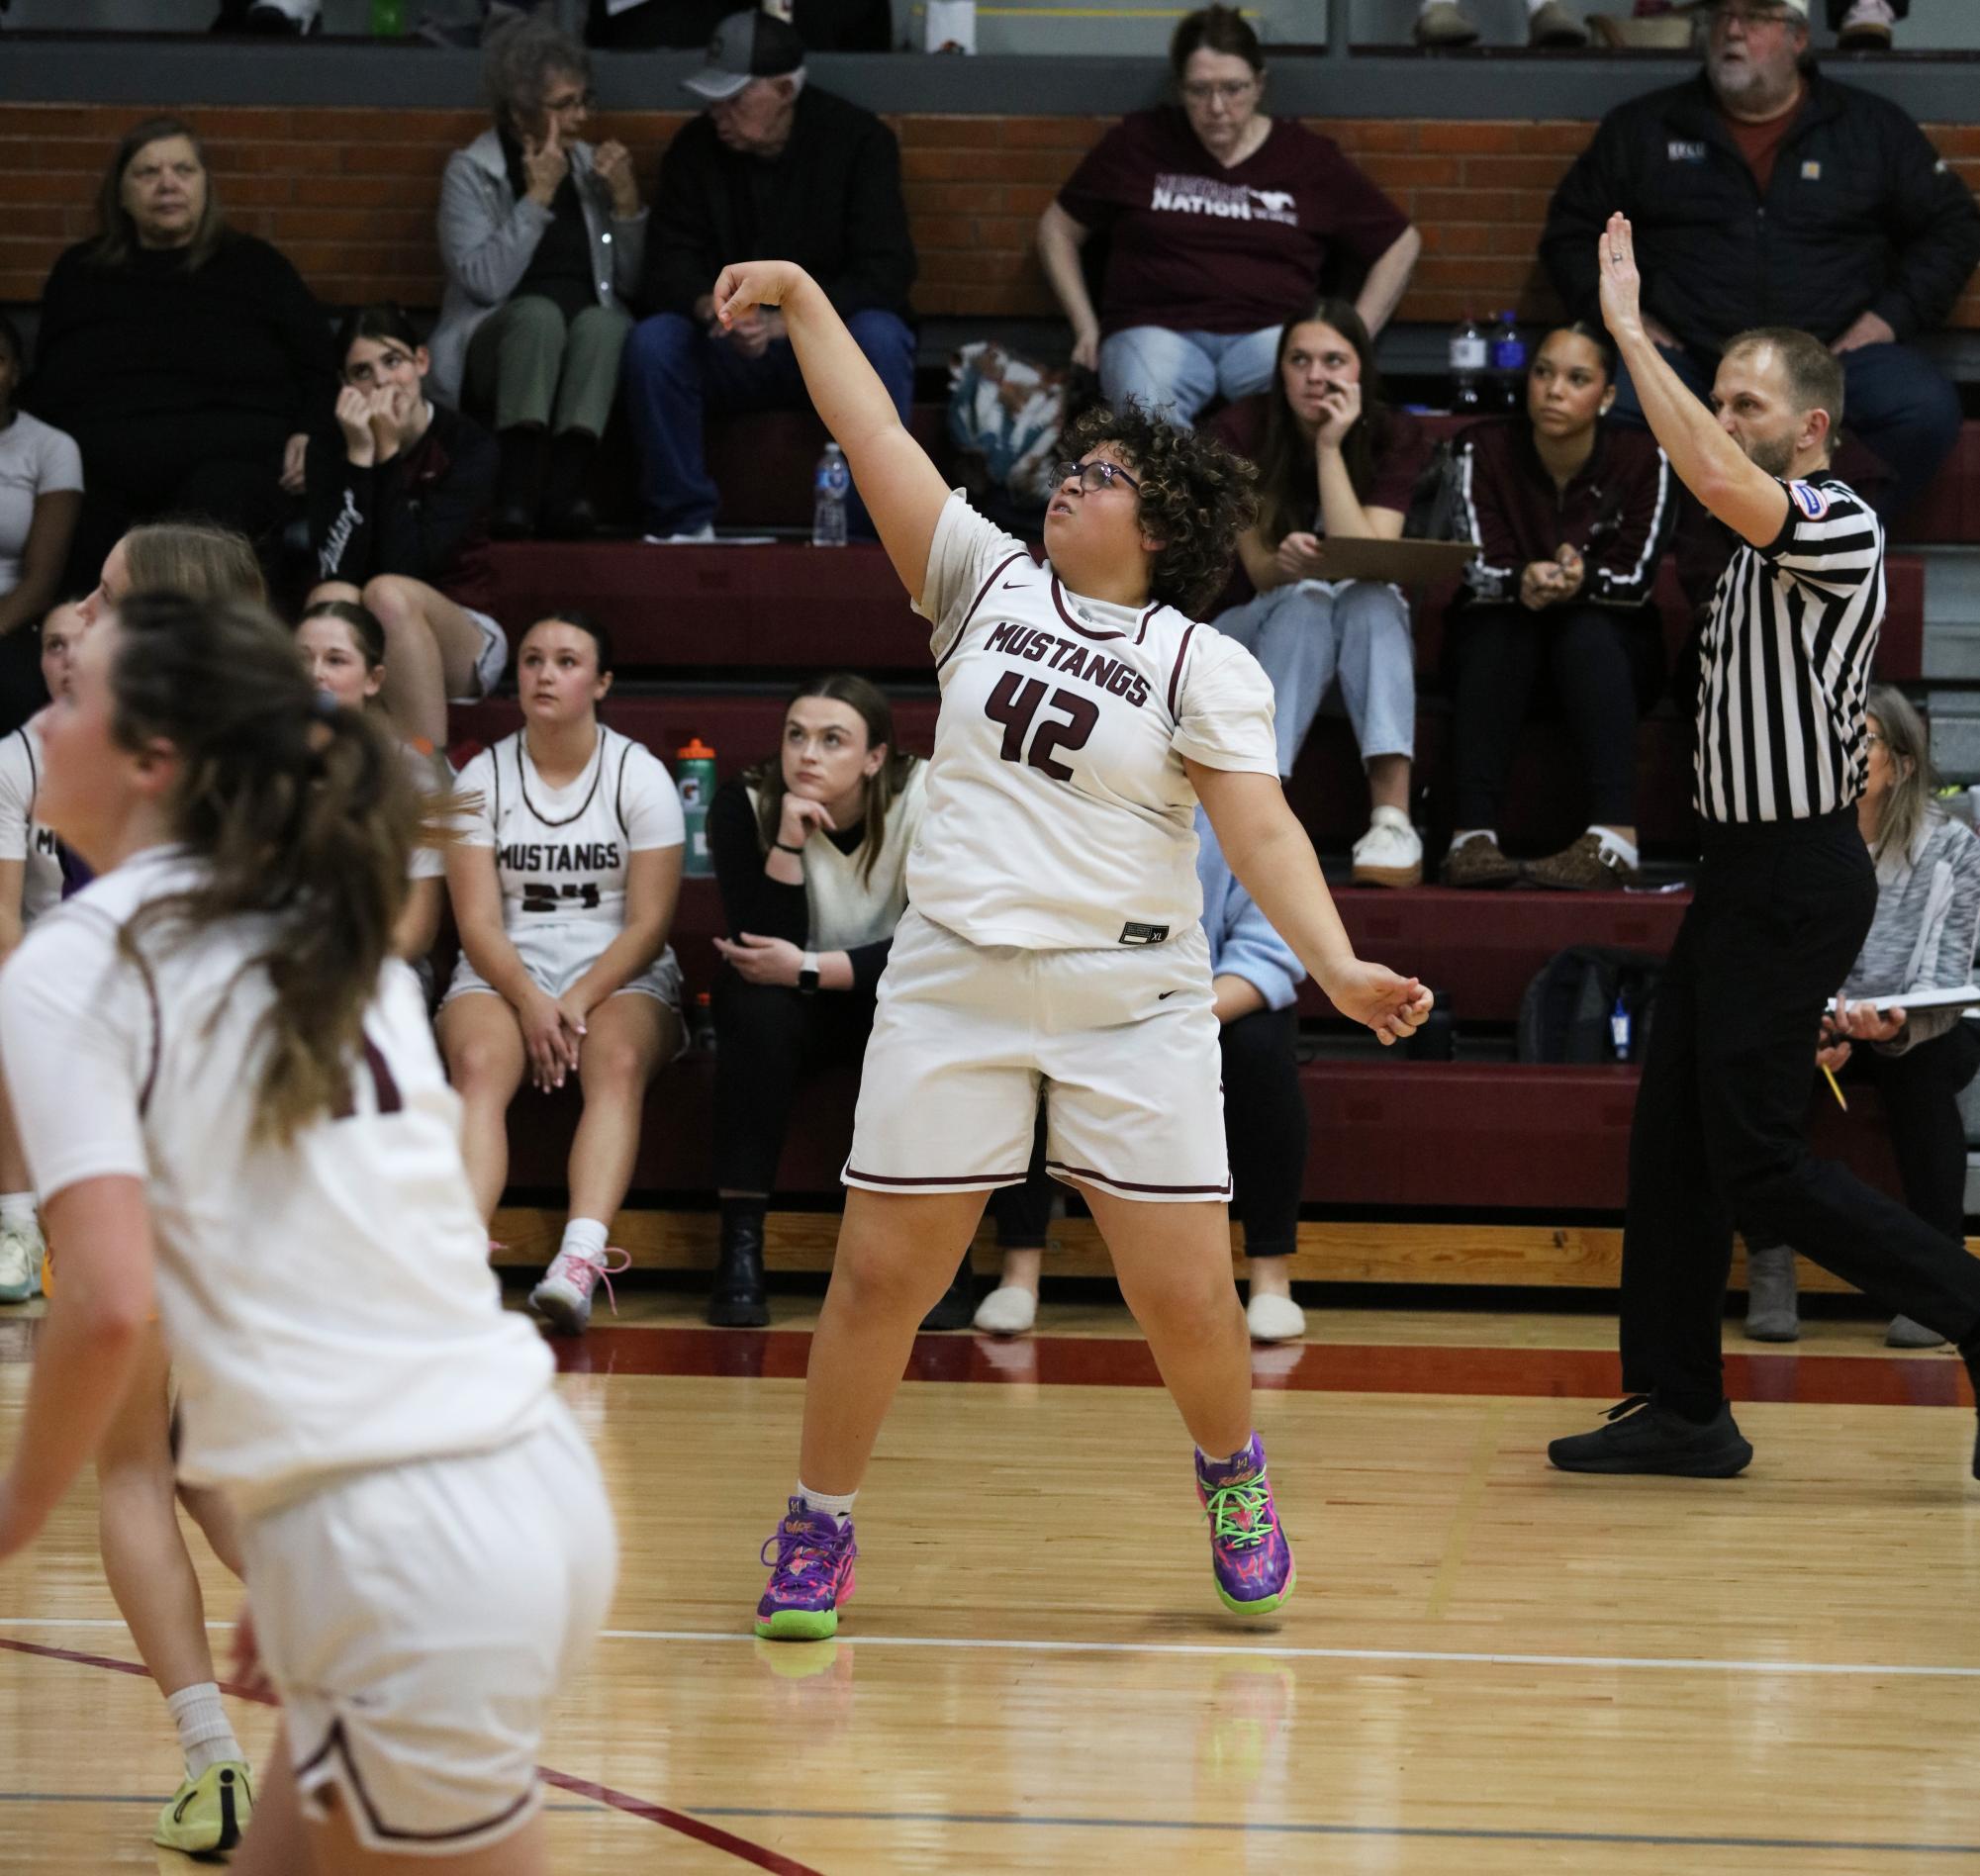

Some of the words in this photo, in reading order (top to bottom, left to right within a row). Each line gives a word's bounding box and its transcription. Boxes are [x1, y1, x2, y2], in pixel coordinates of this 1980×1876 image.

[1151, 187, 1252, 220] NATION
[984, 621, 1151, 707] MUSTANGS
[985, 670, 1099, 782] 42
[497, 843, 619, 871] MUSTANGS
[1151, 932, 1162, 941] XL
